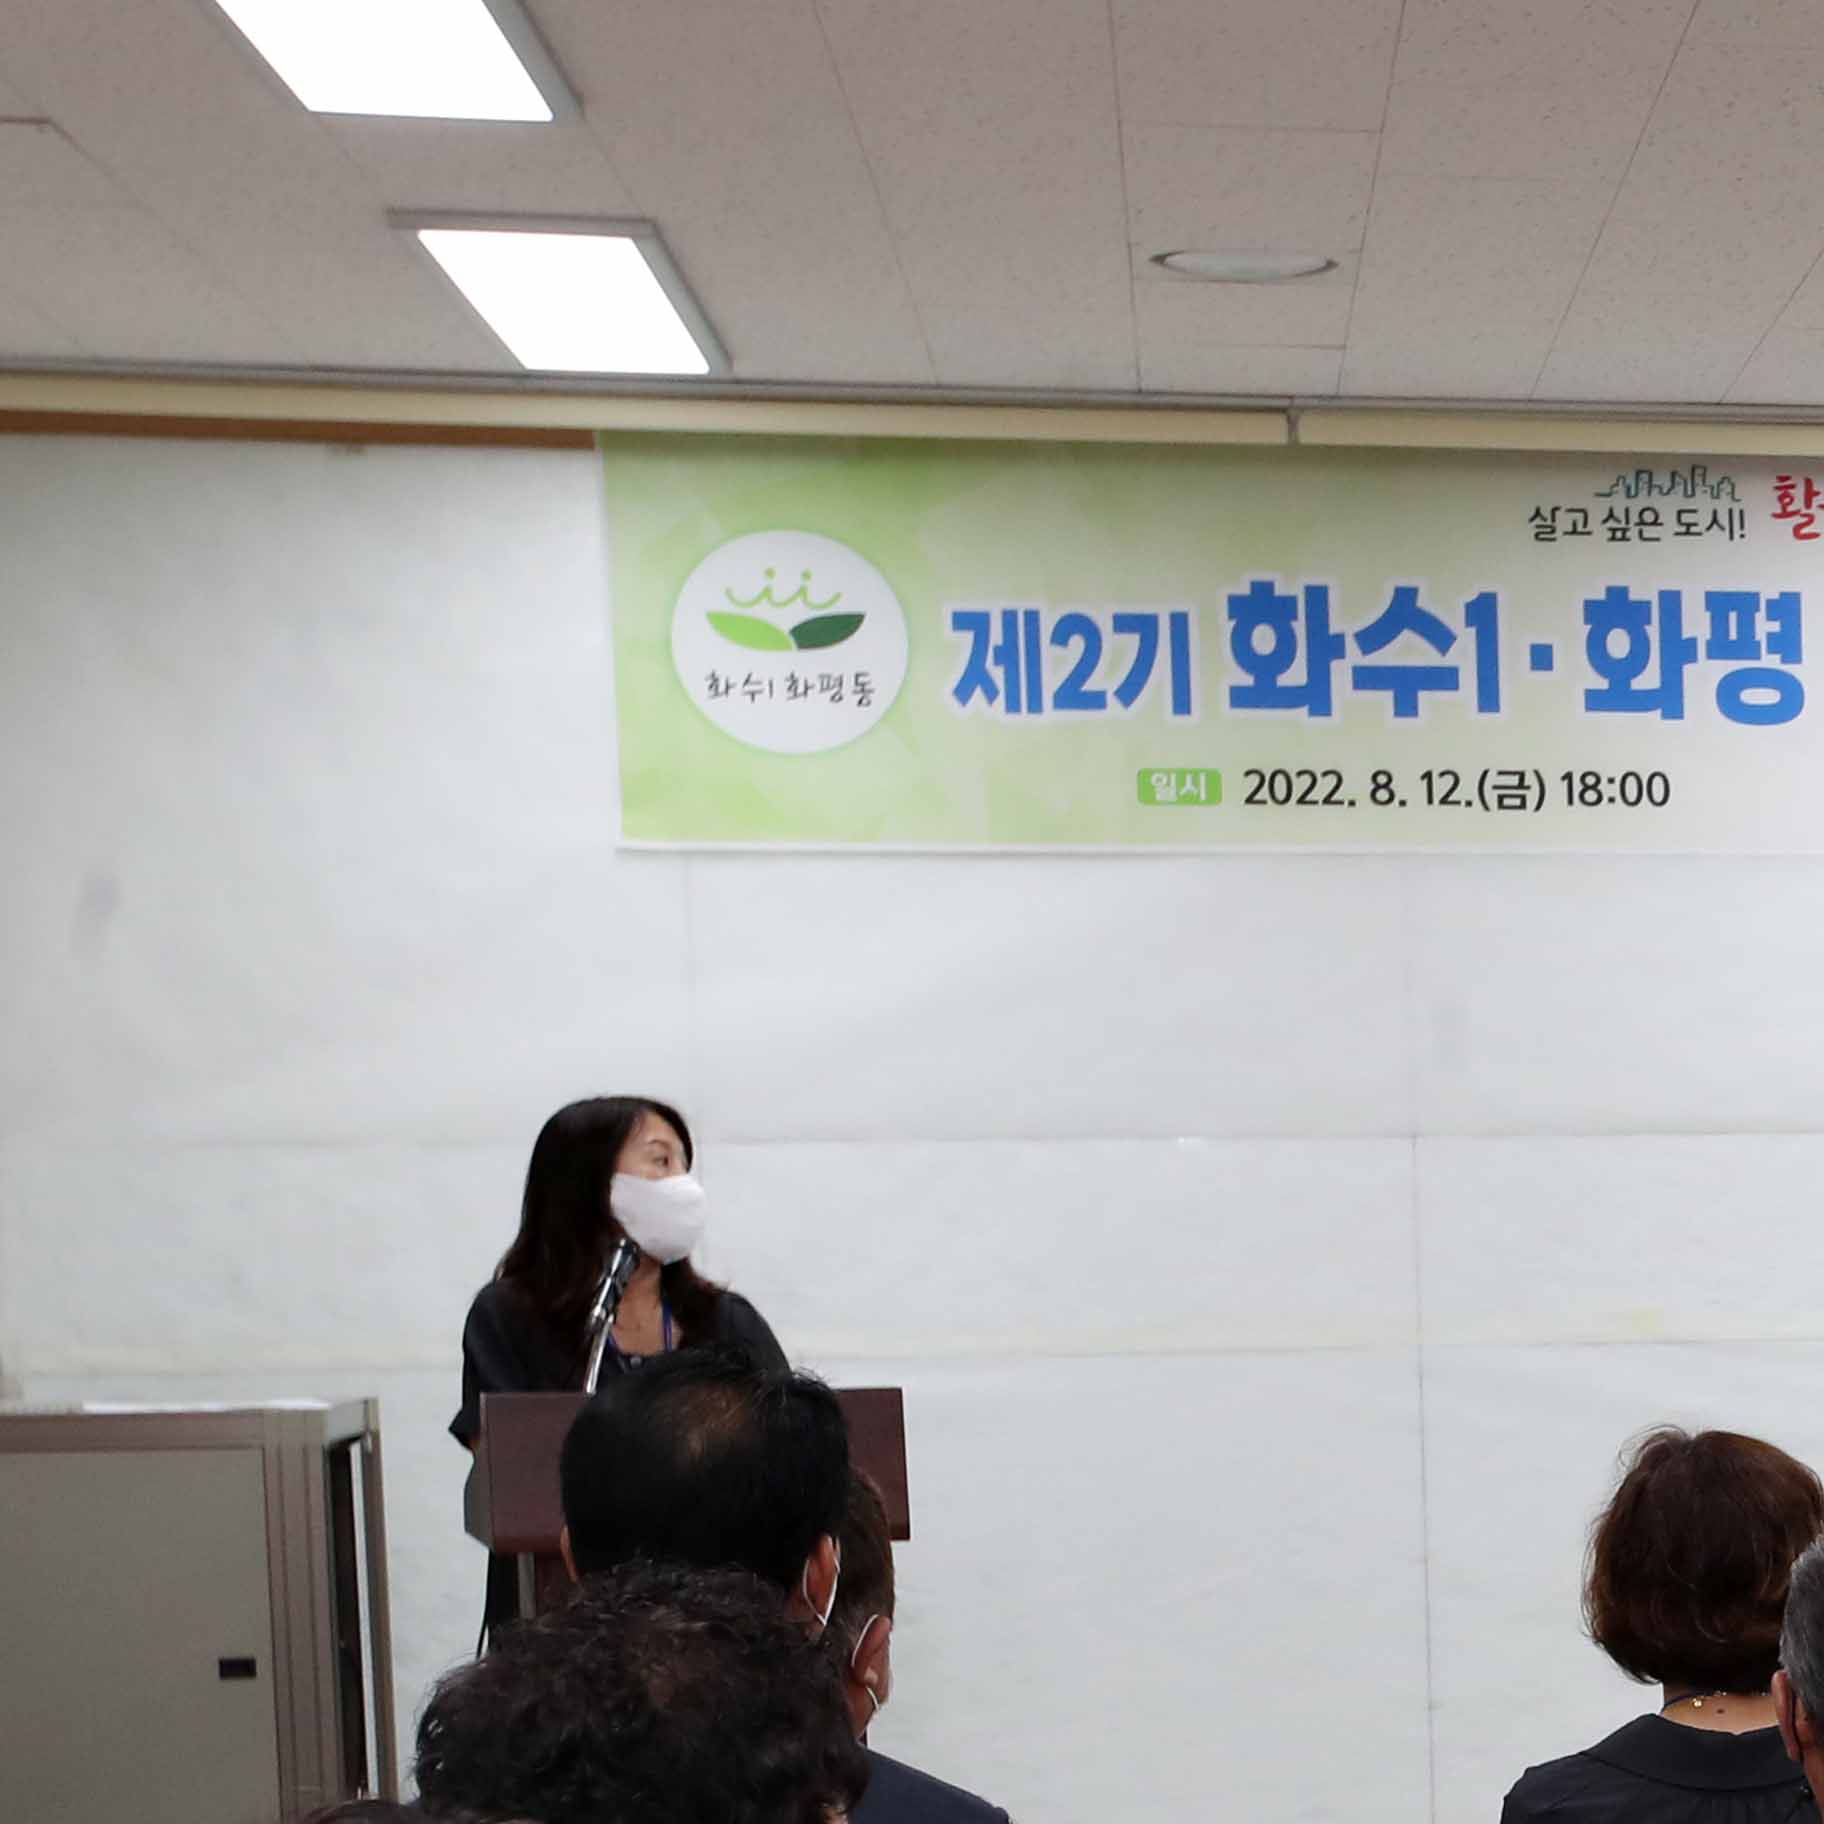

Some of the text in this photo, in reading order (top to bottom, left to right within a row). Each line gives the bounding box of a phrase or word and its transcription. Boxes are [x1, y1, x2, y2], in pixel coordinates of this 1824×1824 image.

[1528, 505, 1593, 541] 살고
[1601, 506, 1664, 542] 싶은
[1673, 505, 1747, 541] 도시!
[951, 608, 1193, 716] 제2기
[1149, 771, 1208, 802] 일시
[1243, 768, 1358, 808] 2022.
[1369, 768, 1408, 808] 8.
[1560, 769, 1672, 808] 18:00
